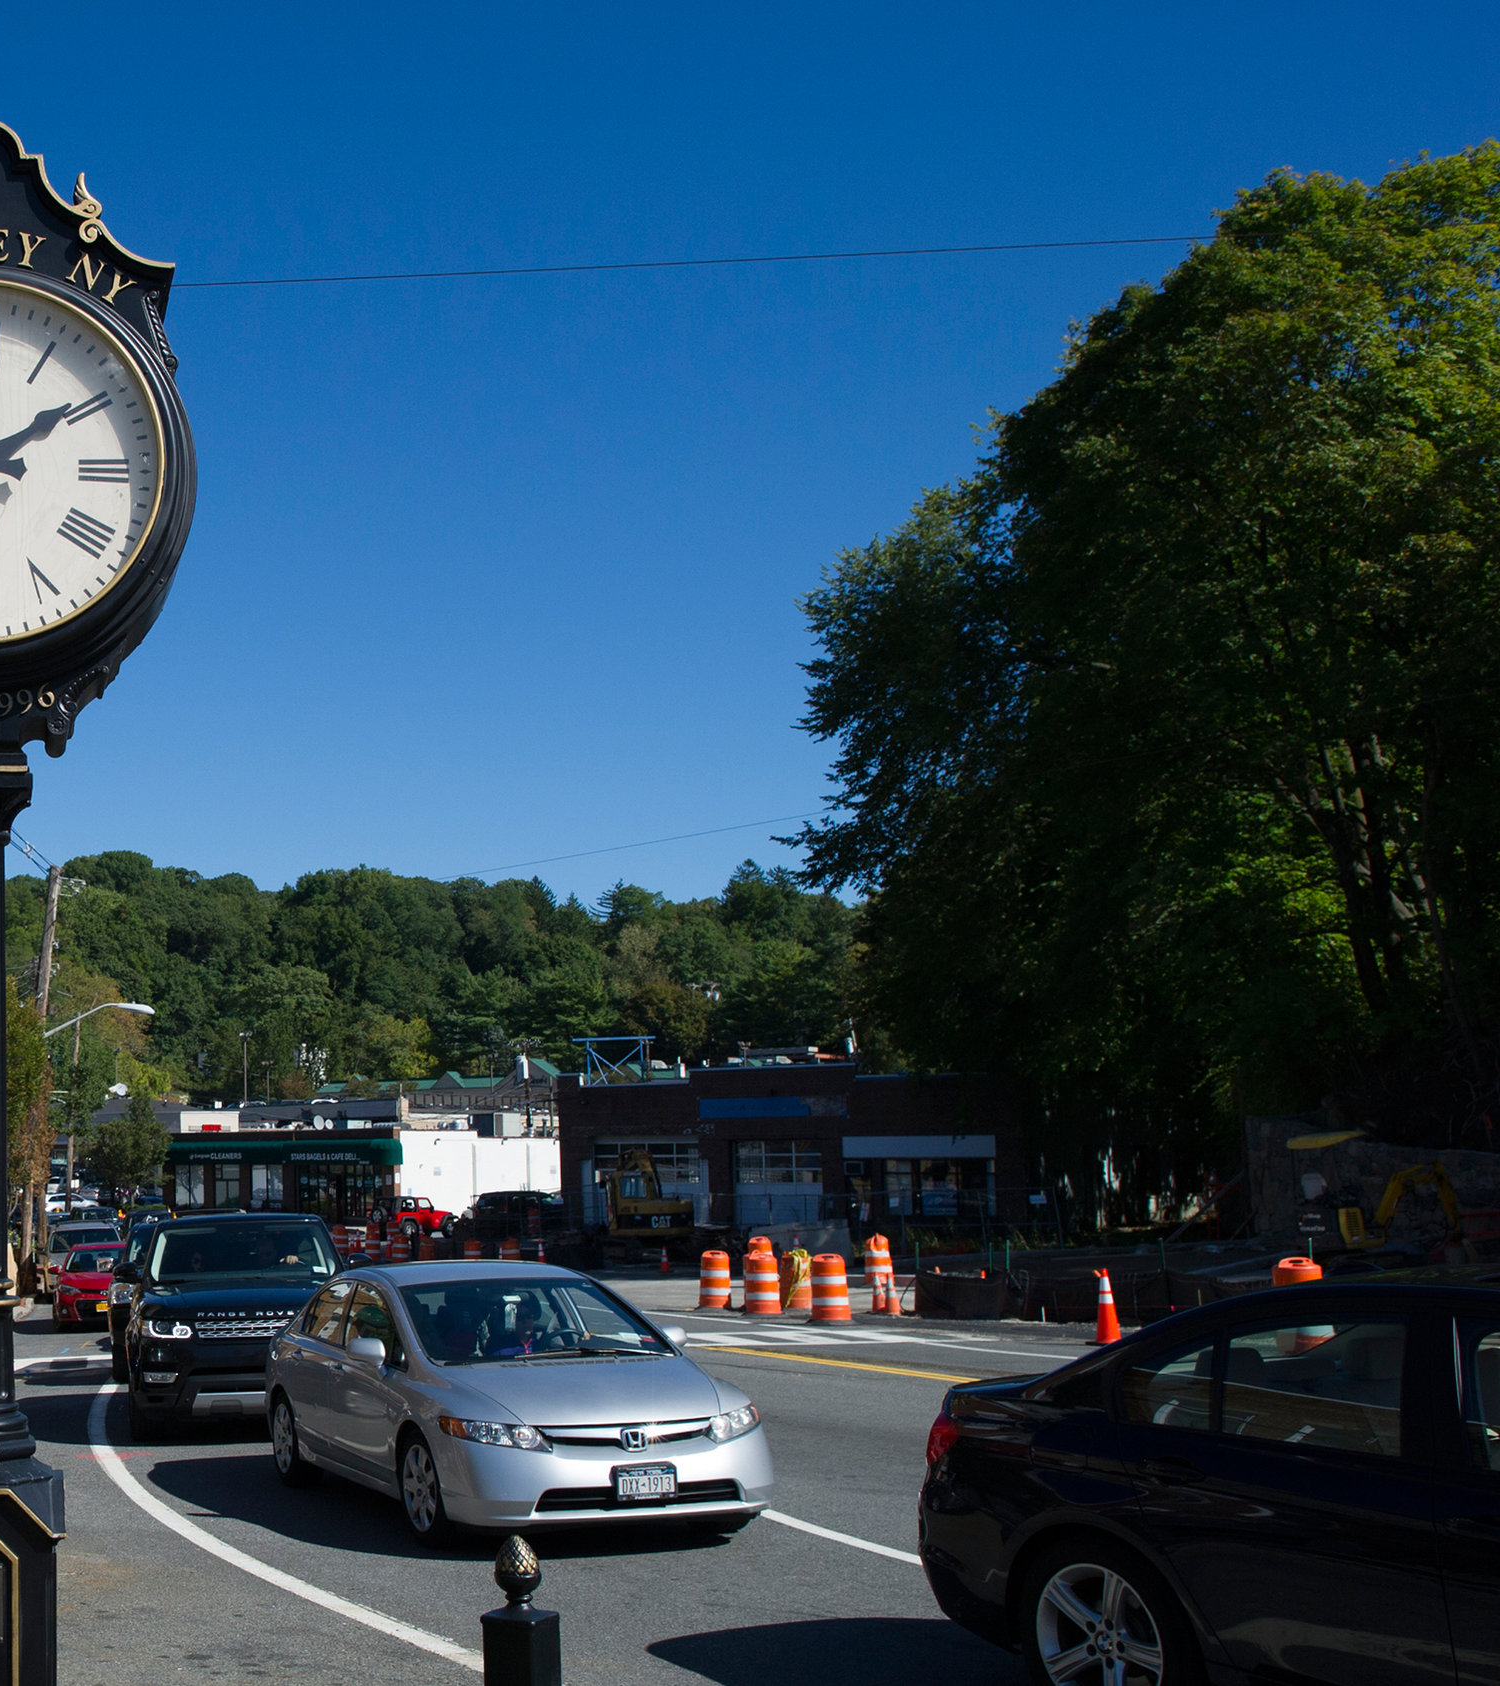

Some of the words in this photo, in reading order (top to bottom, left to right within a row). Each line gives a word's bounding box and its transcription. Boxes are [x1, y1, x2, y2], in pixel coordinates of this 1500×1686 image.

[66, 252, 138, 305] NY
[210, 1152, 242, 1160] CLEANERS
[652, 1216, 671, 1228] CAT
